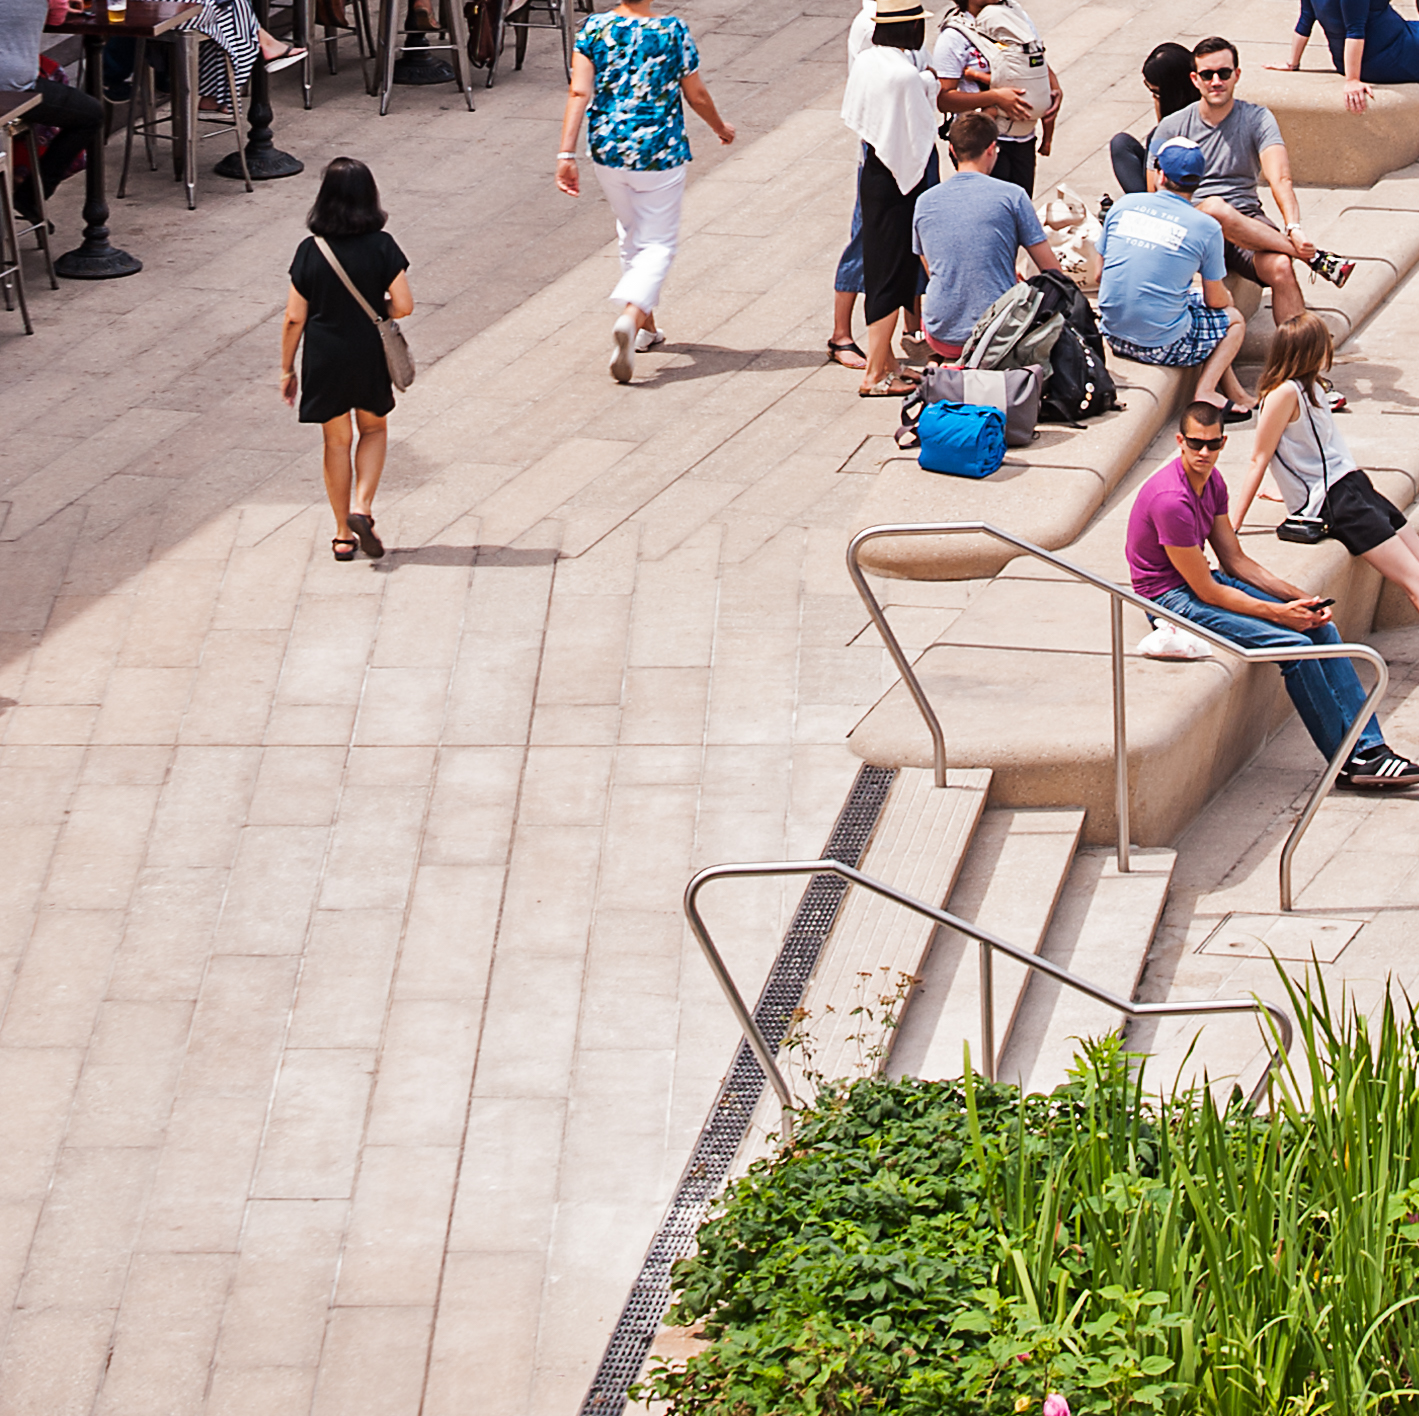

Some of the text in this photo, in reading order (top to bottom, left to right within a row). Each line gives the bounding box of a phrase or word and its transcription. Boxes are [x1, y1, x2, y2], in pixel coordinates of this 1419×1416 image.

[1133, 204, 1181, 223] JOIN THE
[1125, 237, 1158, 251] TODAY
